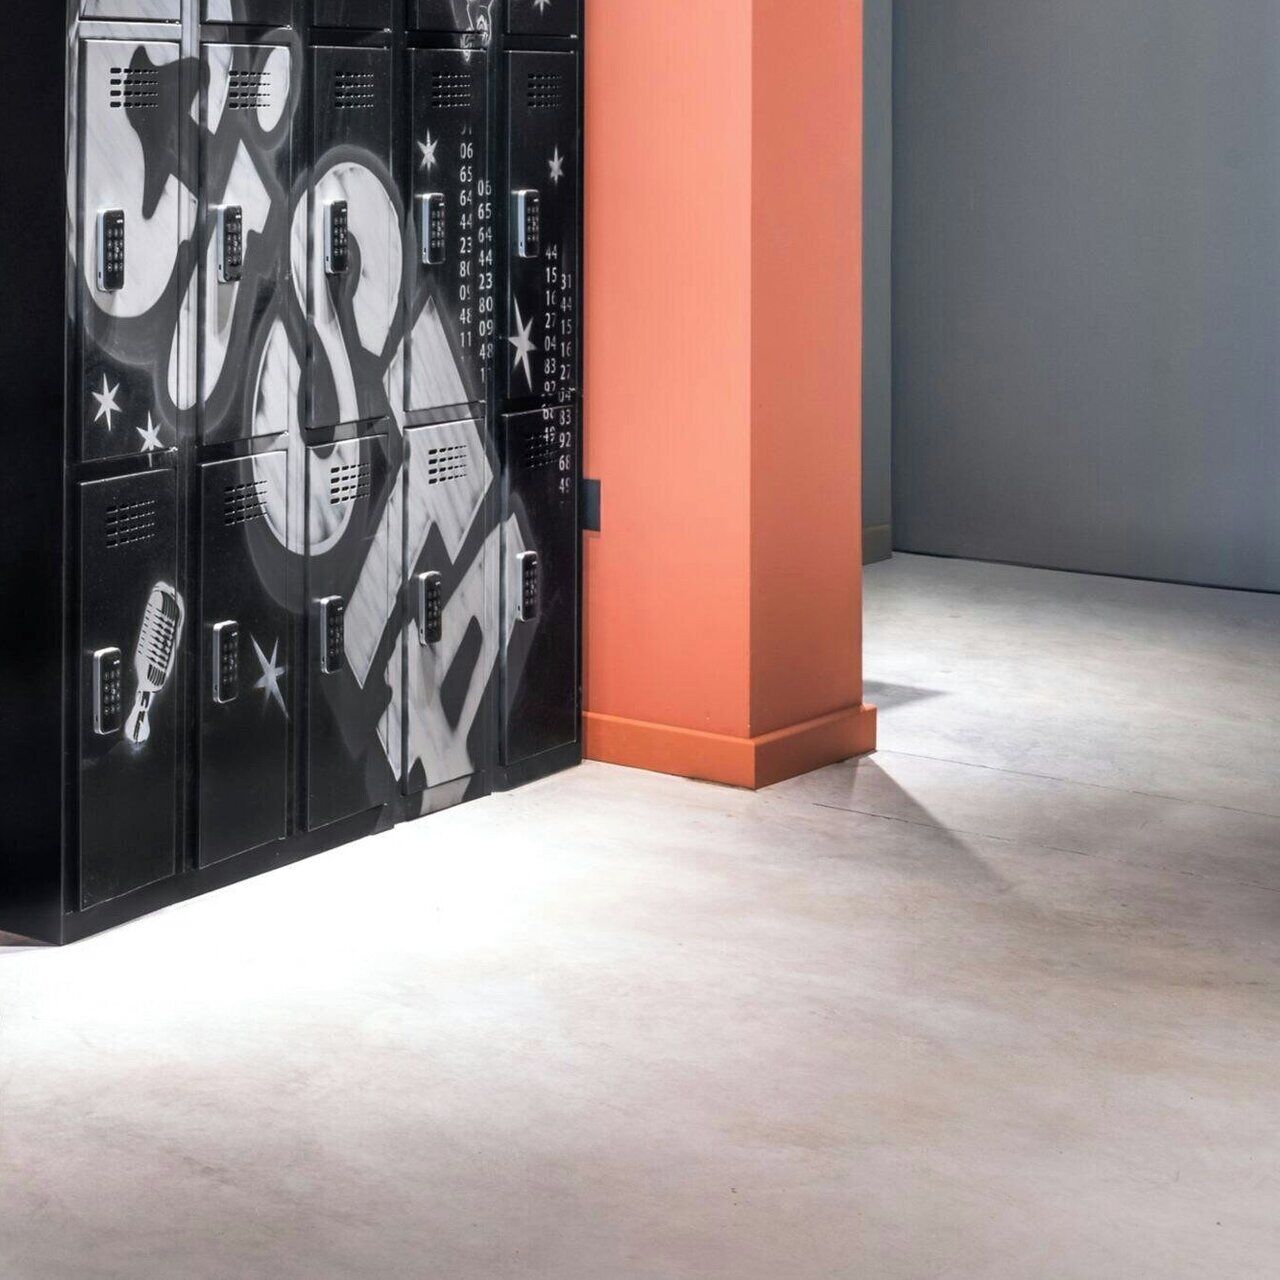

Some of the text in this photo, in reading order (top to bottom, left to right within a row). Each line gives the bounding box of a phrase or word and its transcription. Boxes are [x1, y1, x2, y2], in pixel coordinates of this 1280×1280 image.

[460, 142, 473, 159] 06
[460, 166, 472, 182] 65
[478, 179, 492, 196] 06
[460, 190, 472, 206] 64
[478, 203, 492, 220] 65
[460, 213, 472, 230] 44
[478, 227, 492, 243] 64
[479, 249, 492, 266] 44
[479, 273, 493, 289] 23
[545, 267, 557, 283] 15
[479, 296, 493, 313] 80
[479, 320, 493, 336] 09
[561, 319, 572, 335] 15
[544, 358, 556, 374] 83
[559, 432, 571, 448] 92
